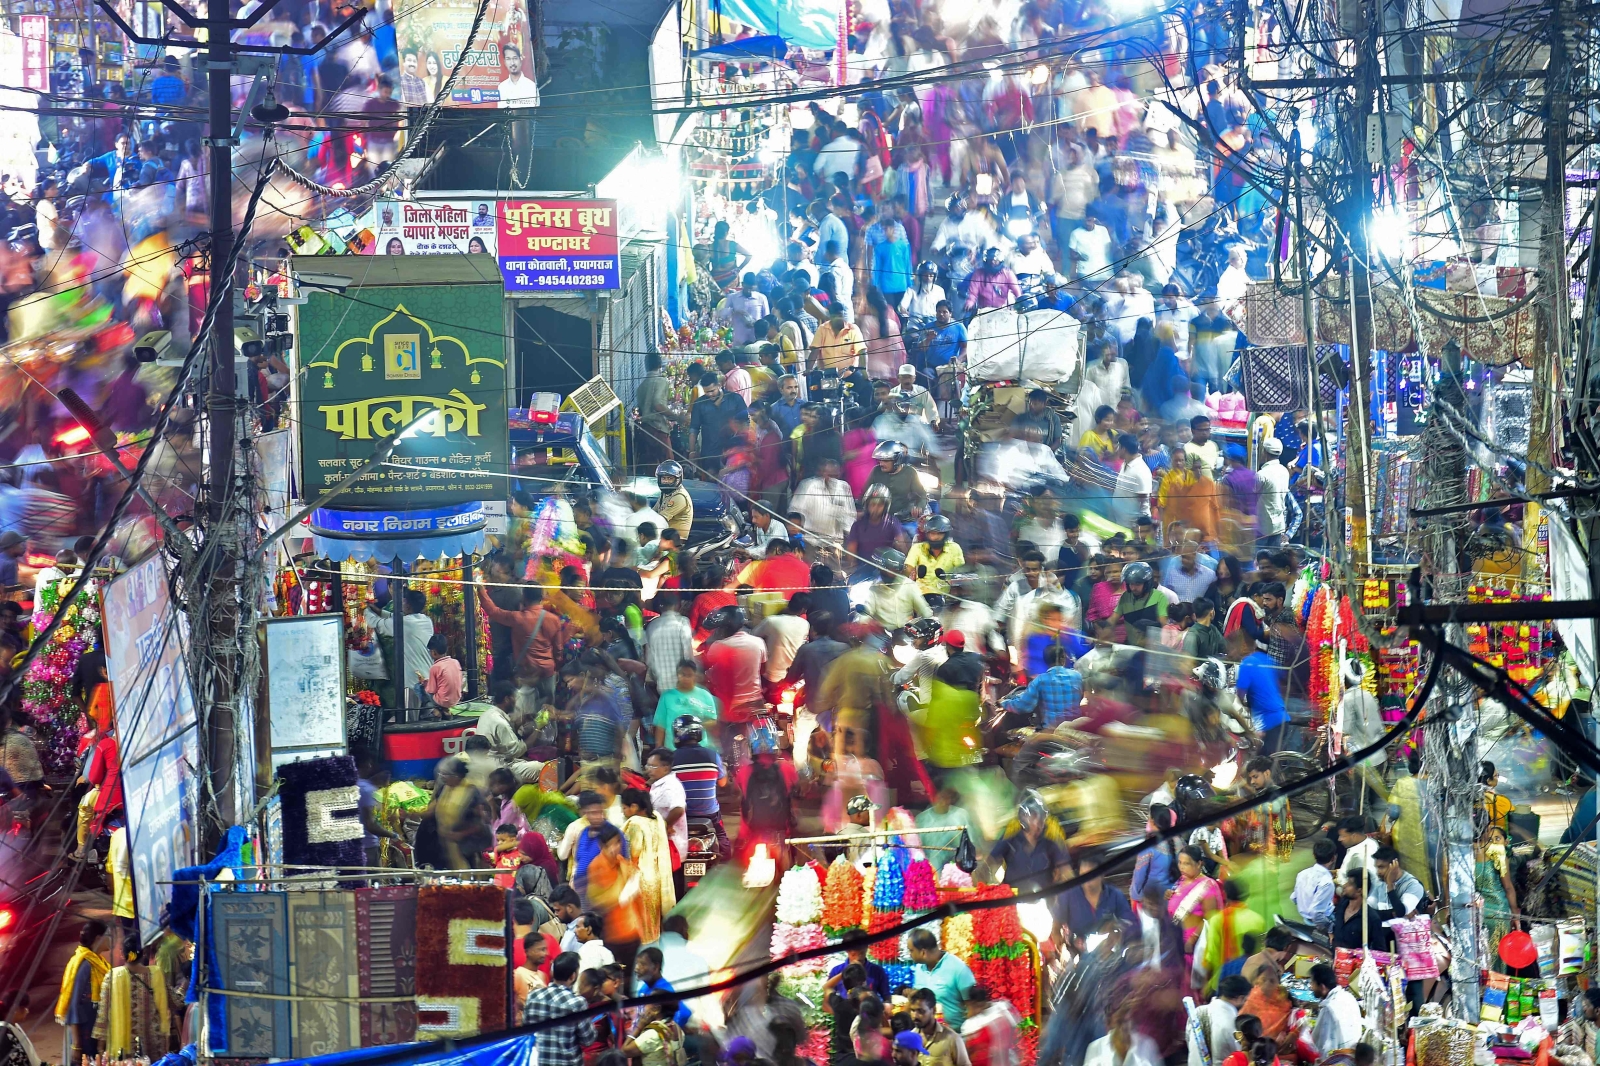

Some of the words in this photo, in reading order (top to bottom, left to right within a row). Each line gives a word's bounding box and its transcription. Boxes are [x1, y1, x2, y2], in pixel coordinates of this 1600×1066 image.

[471, 88, 481, 102] 90
[403, 204, 433, 223] जिला
[434, 204, 468, 223] महिला
[505, 203, 573, 235] पुलिस
[576, 207, 612, 235] बूथ
[402, 225, 436, 240] व्यापार
[438, 225, 470, 240] मण्डल
[526, 236, 591, 251] घण्टाघर
[505, 260, 526, 271] थाना
[527, 258, 571, 272] कोतवाली,
[573, 260, 614, 270] प्रयागराज
[515, 273, 605, 286] मो.-9454402839
[317, 388, 487, 440] पालकी
[318, 458, 346, 468] सलवार
[348, 458, 363, 469] सूट
[415, 456, 440, 465] गाउन्स
[342, 519, 380, 532] नगर
[383, 516, 432, 531] निगम
